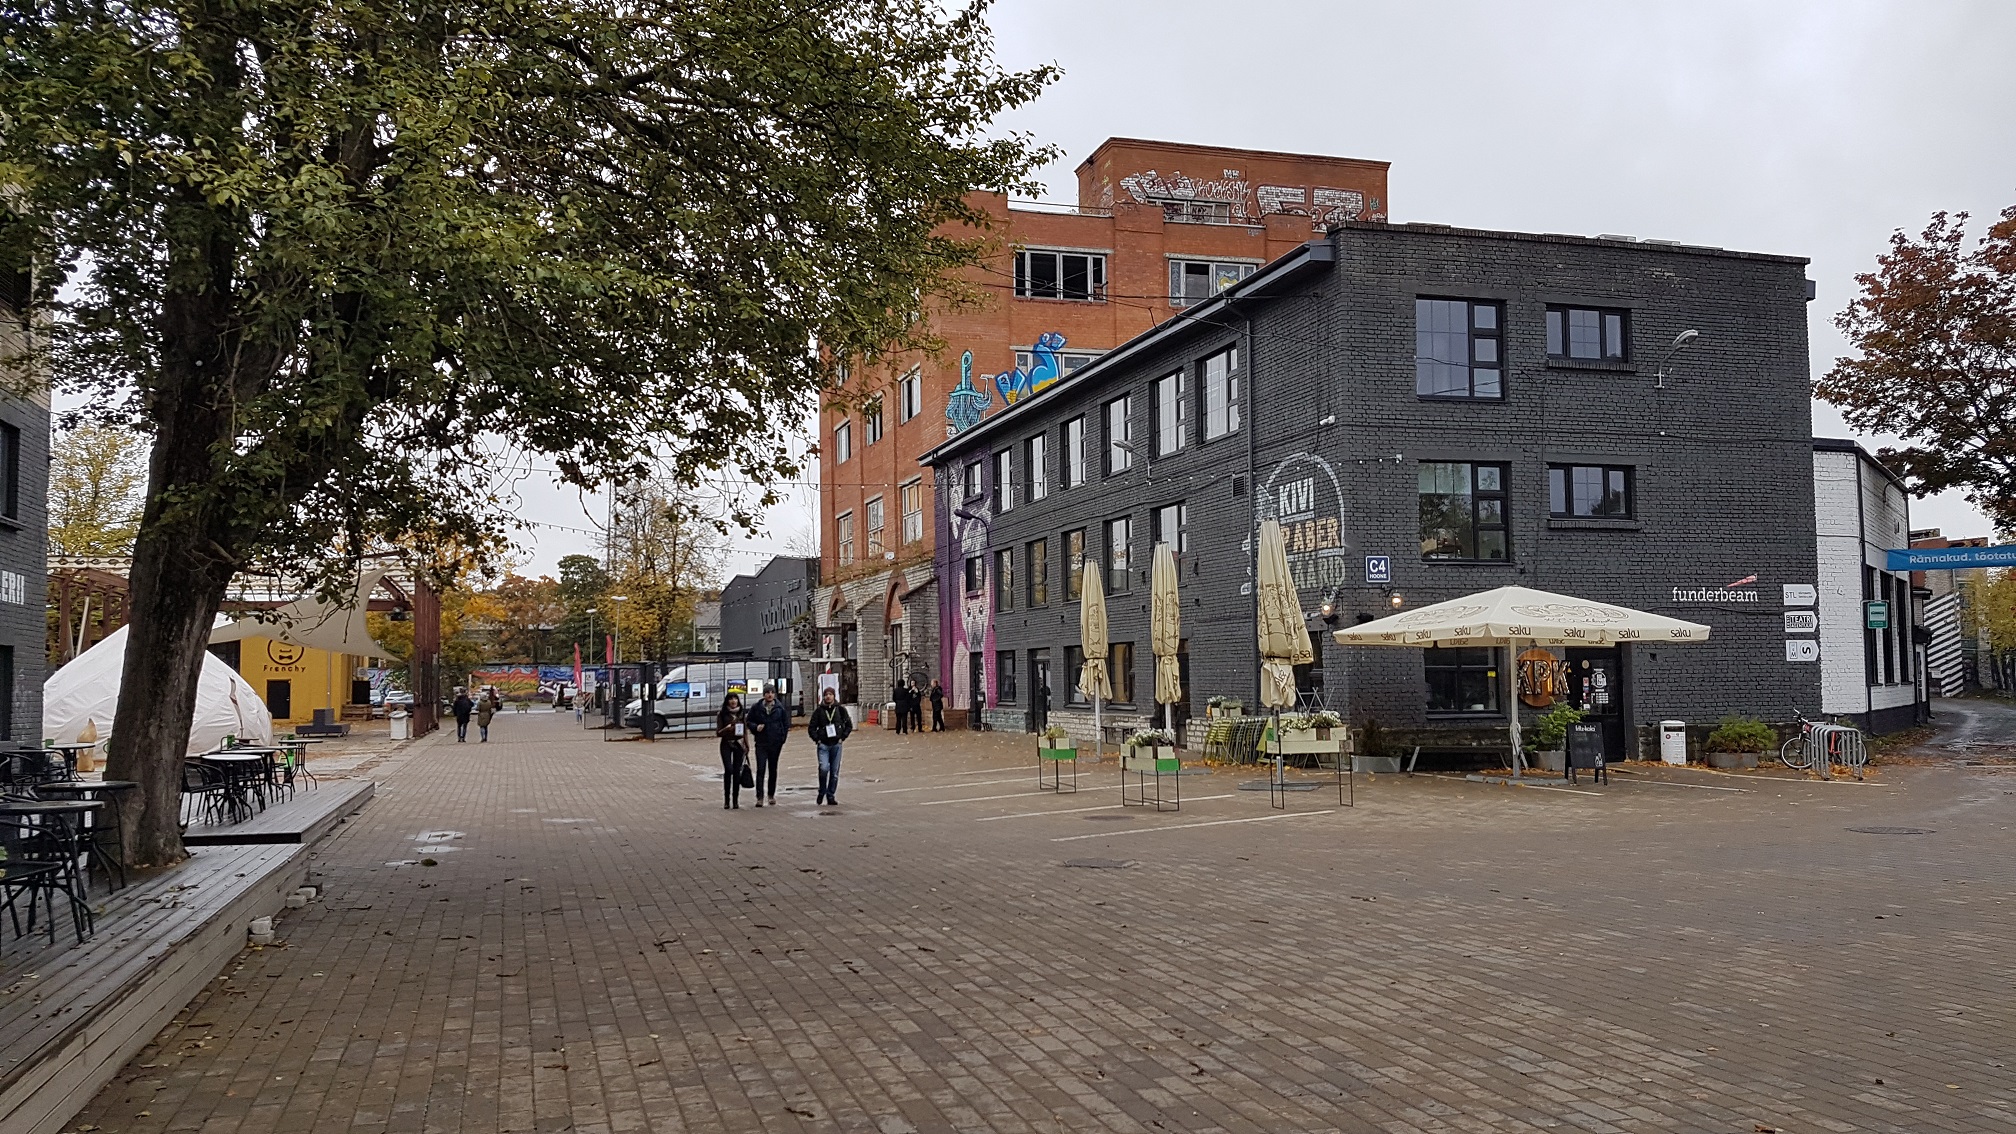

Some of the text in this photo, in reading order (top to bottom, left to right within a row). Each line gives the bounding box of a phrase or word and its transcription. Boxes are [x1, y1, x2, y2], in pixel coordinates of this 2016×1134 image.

[1279, 477, 1315, 516] KIVI
[1288, 552, 1346, 590] ÄÄRID
[1370, 559, 1386, 573] C4
[1672, 587, 1758, 602] funderbeam
[1415, 629, 1432, 640] saku
[1454, 625, 1471, 637] saku
[1508, 625, 1532, 636] saku
[1564, 626, 1586, 639] saku
[1618, 628, 1641, 639] saku
[1670, 627, 1692, 638] saku
[1380, 633, 1397, 641] saku
[263, 664, 306, 673] Frenchy
[1516, 660, 1571, 695] KPK
